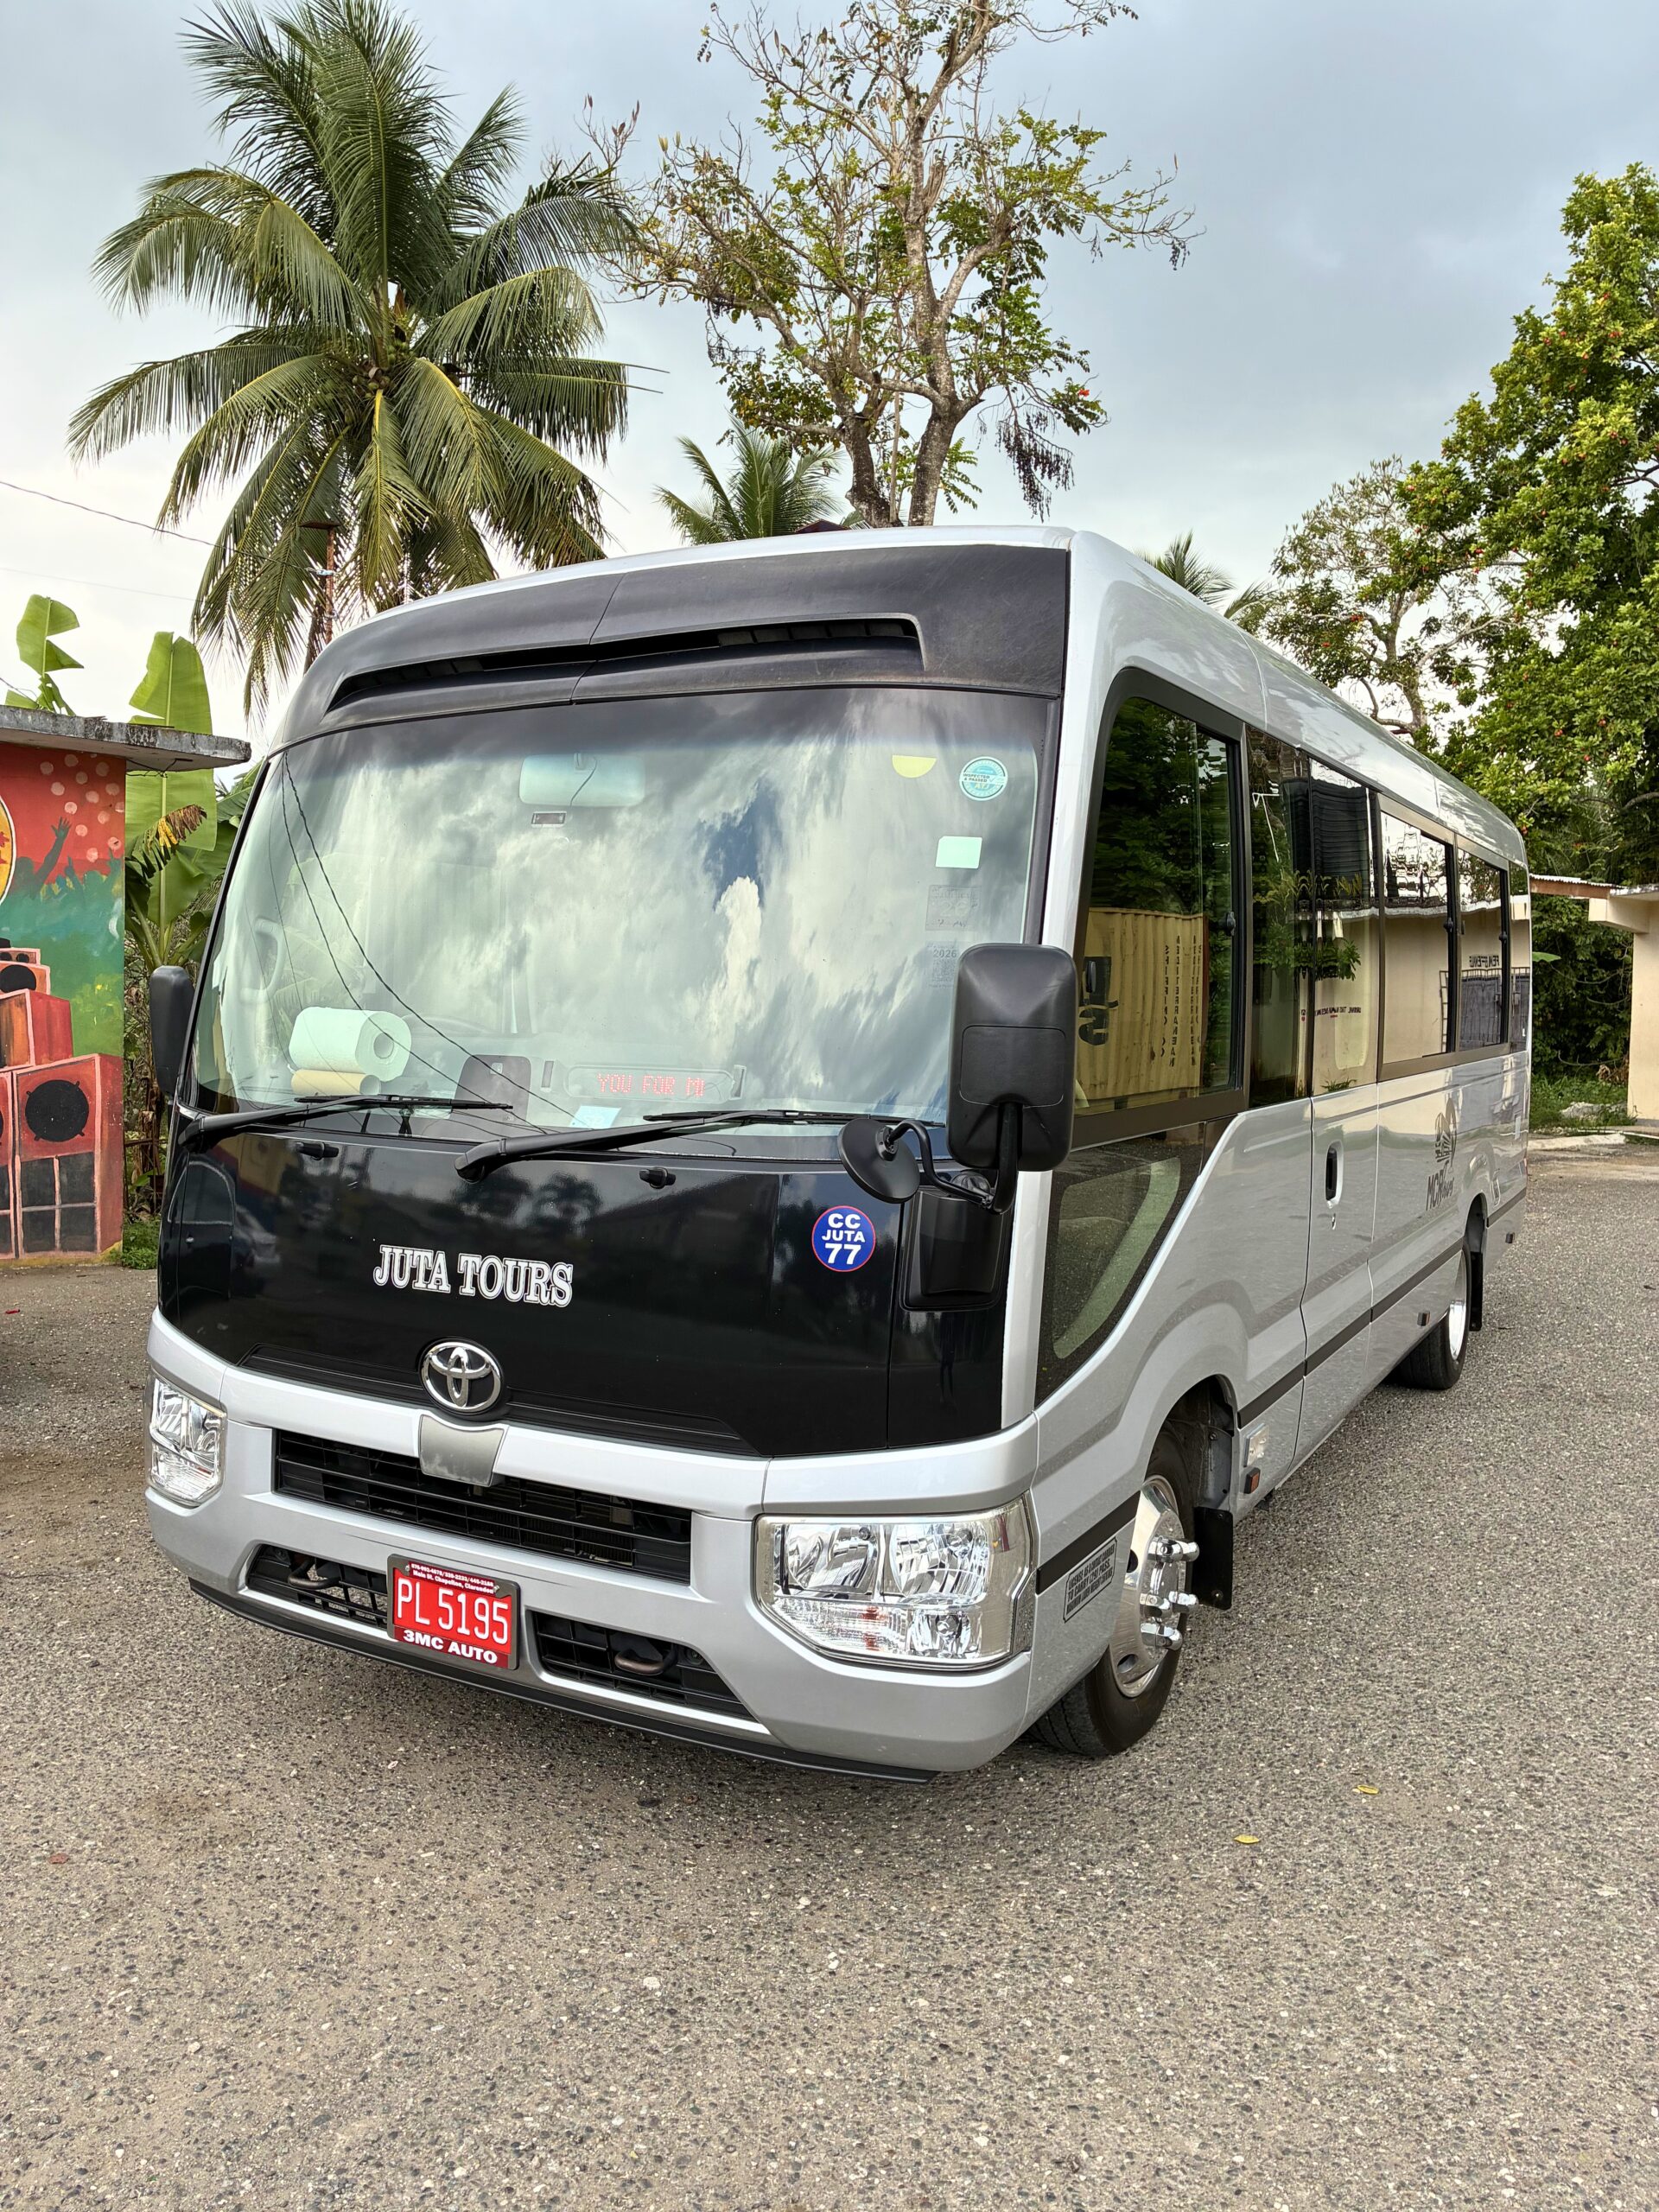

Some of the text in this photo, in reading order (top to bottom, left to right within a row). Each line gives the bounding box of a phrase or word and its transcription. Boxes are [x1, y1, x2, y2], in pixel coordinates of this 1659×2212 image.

[933, 949, 957, 958] 2026
[596, 1072, 633, 1094] YOU
[641, 1074, 675, 1096] FOR
[828, 1213, 861, 1230] CC
[821, 1229, 866, 1243] JUTA
[824, 1243, 861, 1265] 77
[372, 1244, 574, 1308] JUTA TOURS
[397, 1578, 509, 1645] PL 5195
[403, 1630, 498, 1664] 3MC AUTO
